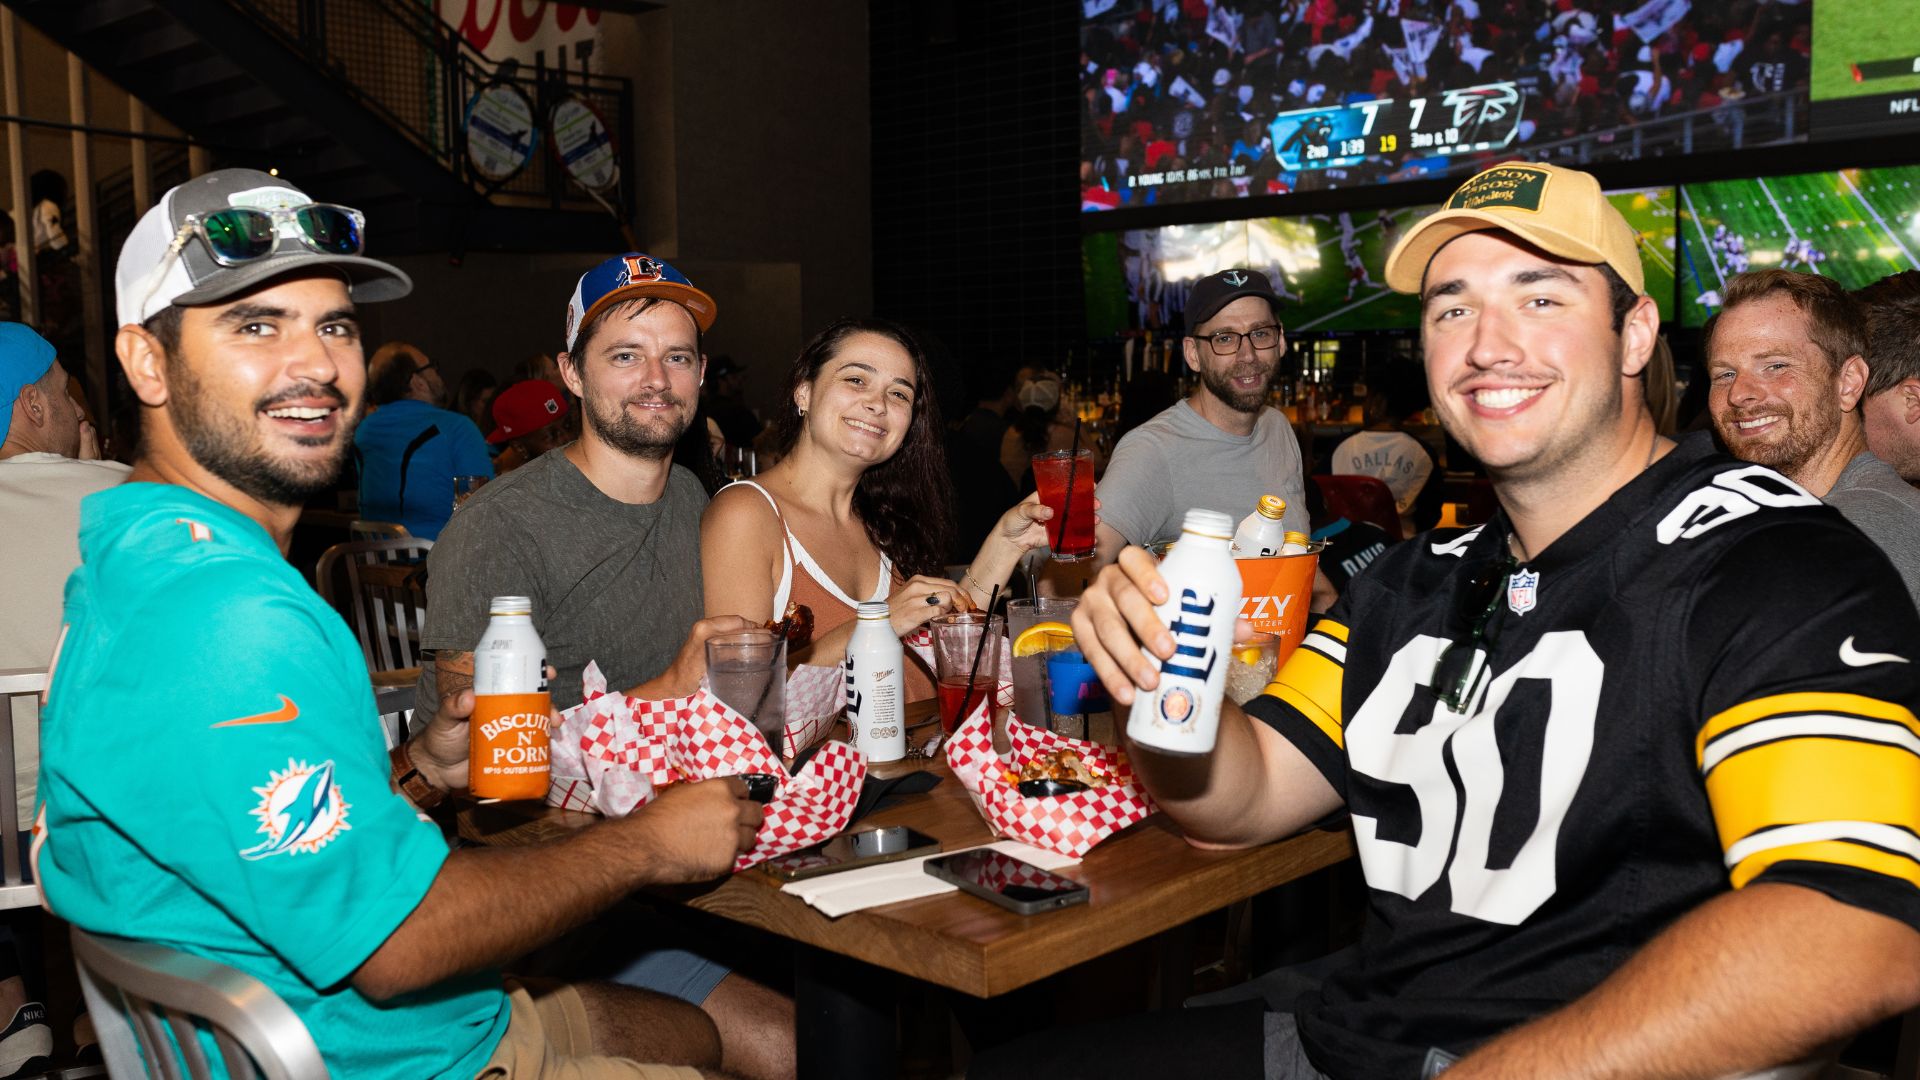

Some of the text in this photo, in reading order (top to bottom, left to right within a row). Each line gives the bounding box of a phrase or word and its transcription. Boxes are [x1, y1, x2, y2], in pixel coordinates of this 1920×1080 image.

[1362, 98, 1427, 136] 7 7
[1890, 98, 1920, 114] NFL
[1340, 139, 1365, 156] 1:39
[1380, 134, 1397, 152] 19
[1352, 452, 1414, 474] DALLAS
[1238, 594, 1292, 619] ZZY
[1161, 587, 1217, 685] Lite
[493, 746, 548, 765] PORN
[1344, 629, 1605, 926] 90
[23, 1010, 45, 1021] NIKE
